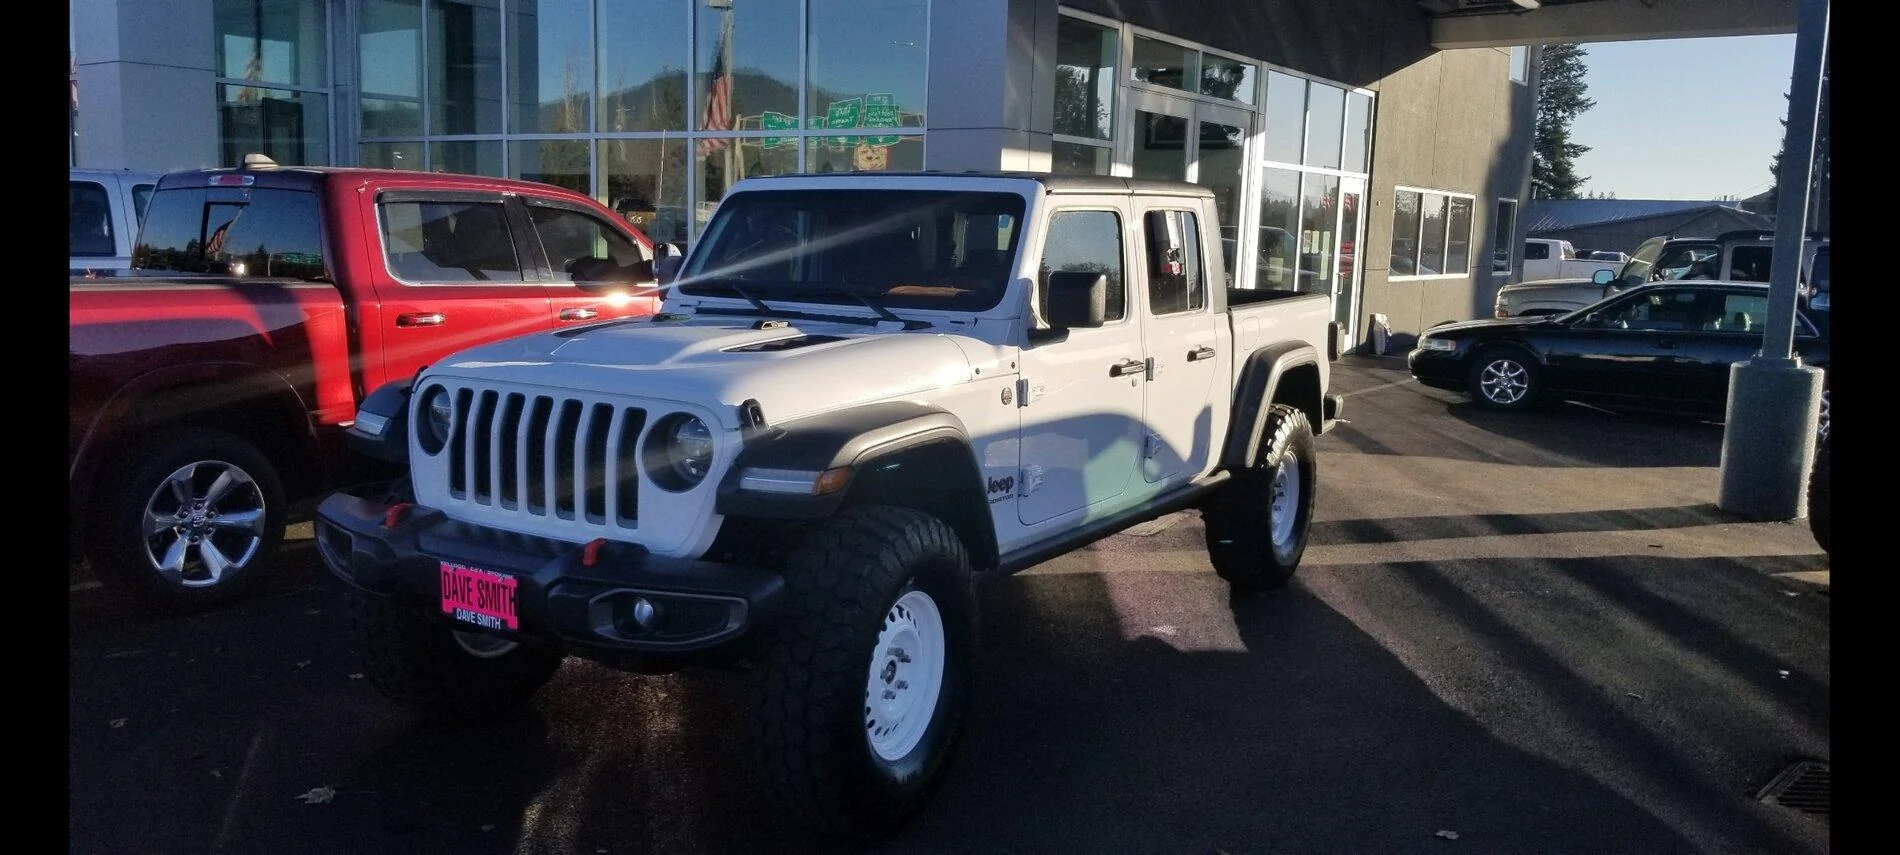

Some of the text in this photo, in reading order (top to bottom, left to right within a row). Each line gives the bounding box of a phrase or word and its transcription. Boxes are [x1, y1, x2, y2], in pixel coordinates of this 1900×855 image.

[987, 475, 1014, 494] Jeep
[443, 570, 517, 617] DAVE SMITH
[456, 608, 501, 630] DAVE SMITH
